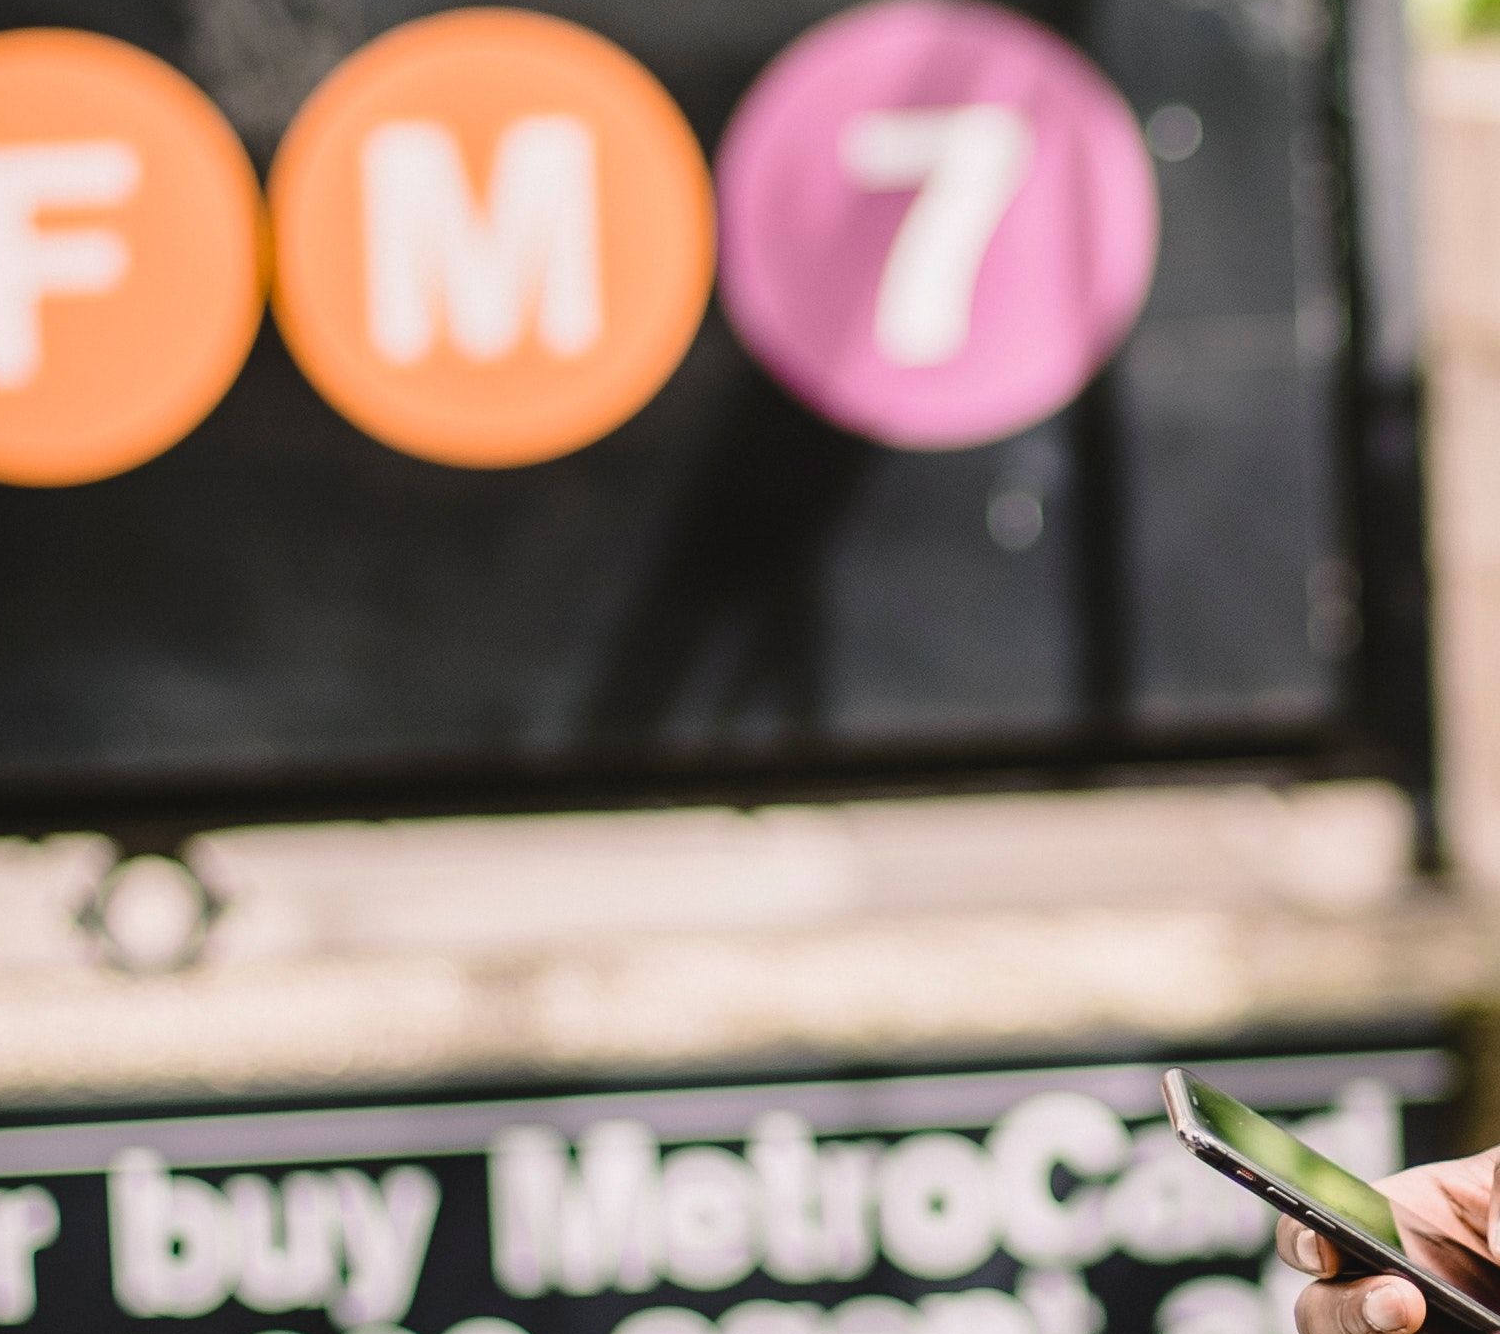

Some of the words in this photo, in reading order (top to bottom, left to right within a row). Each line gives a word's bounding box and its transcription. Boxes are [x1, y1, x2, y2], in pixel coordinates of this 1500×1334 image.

[361, 113, 605, 368] M
[836, 103, 1033, 368] 7
[104, 1147, 443, 1330] buy
